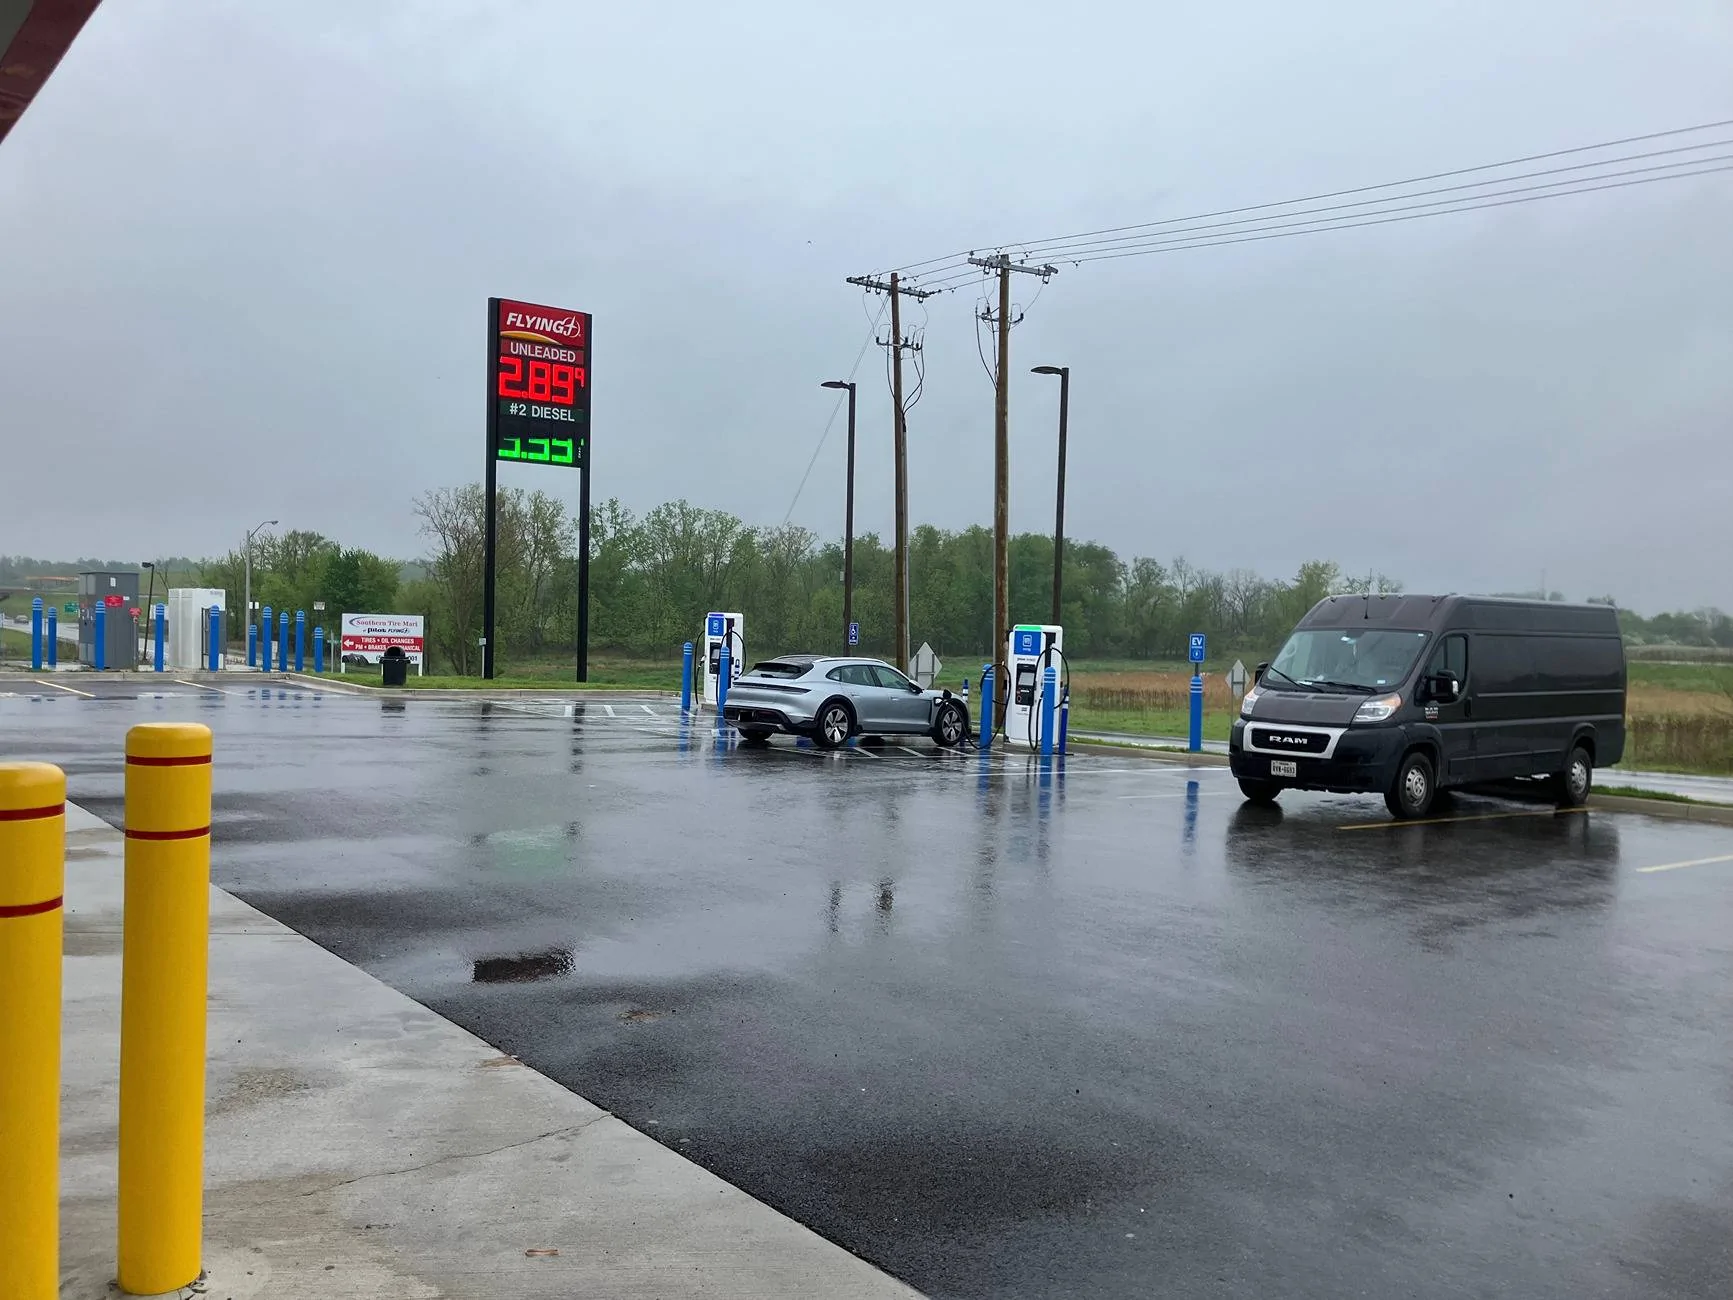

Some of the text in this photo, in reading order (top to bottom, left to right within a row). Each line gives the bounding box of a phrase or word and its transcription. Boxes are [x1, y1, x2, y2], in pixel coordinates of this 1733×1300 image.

[507, 312, 563, 334] FLYING
[510, 342, 576, 362] UNLEADED
[509, 402, 575, 422] #2 DIESEL
[1191, 637, 1203, 646] EV
[1269, 735, 1308, 745] RAM
